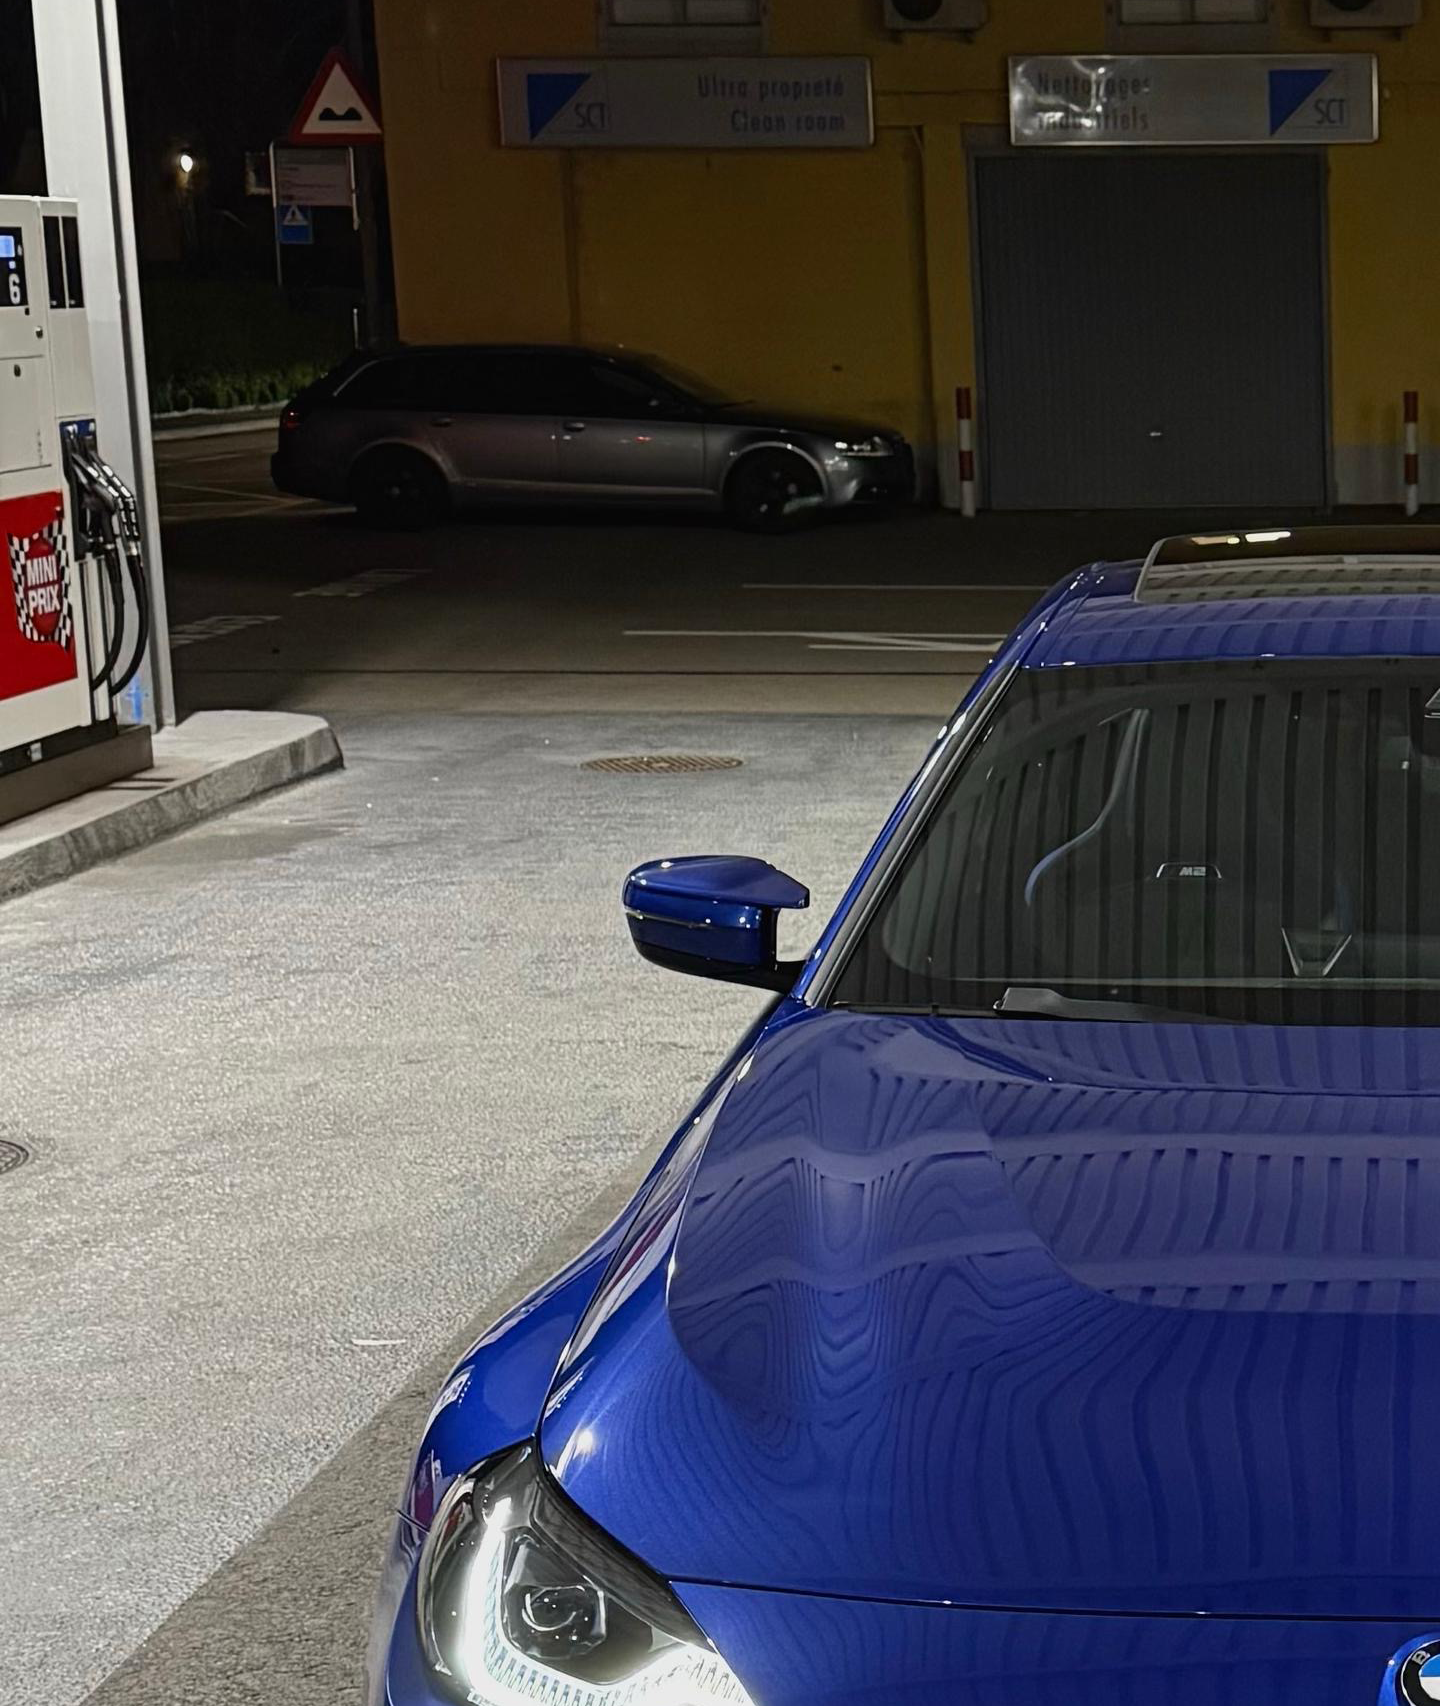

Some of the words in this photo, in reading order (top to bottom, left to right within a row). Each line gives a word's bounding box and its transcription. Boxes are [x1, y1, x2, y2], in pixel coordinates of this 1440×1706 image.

[697, 73, 747, 97] Ultra
[574, 102, 605, 128] SCT
[731, 109, 786, 131] Clean
[797, 115, 845, 131] room
[1314, 98, 1344, 125] SCT
[8, 273, 21, 305] 6
[26, 554, 58, 587] MINI
[27, 584, 61, 618] PRIX
